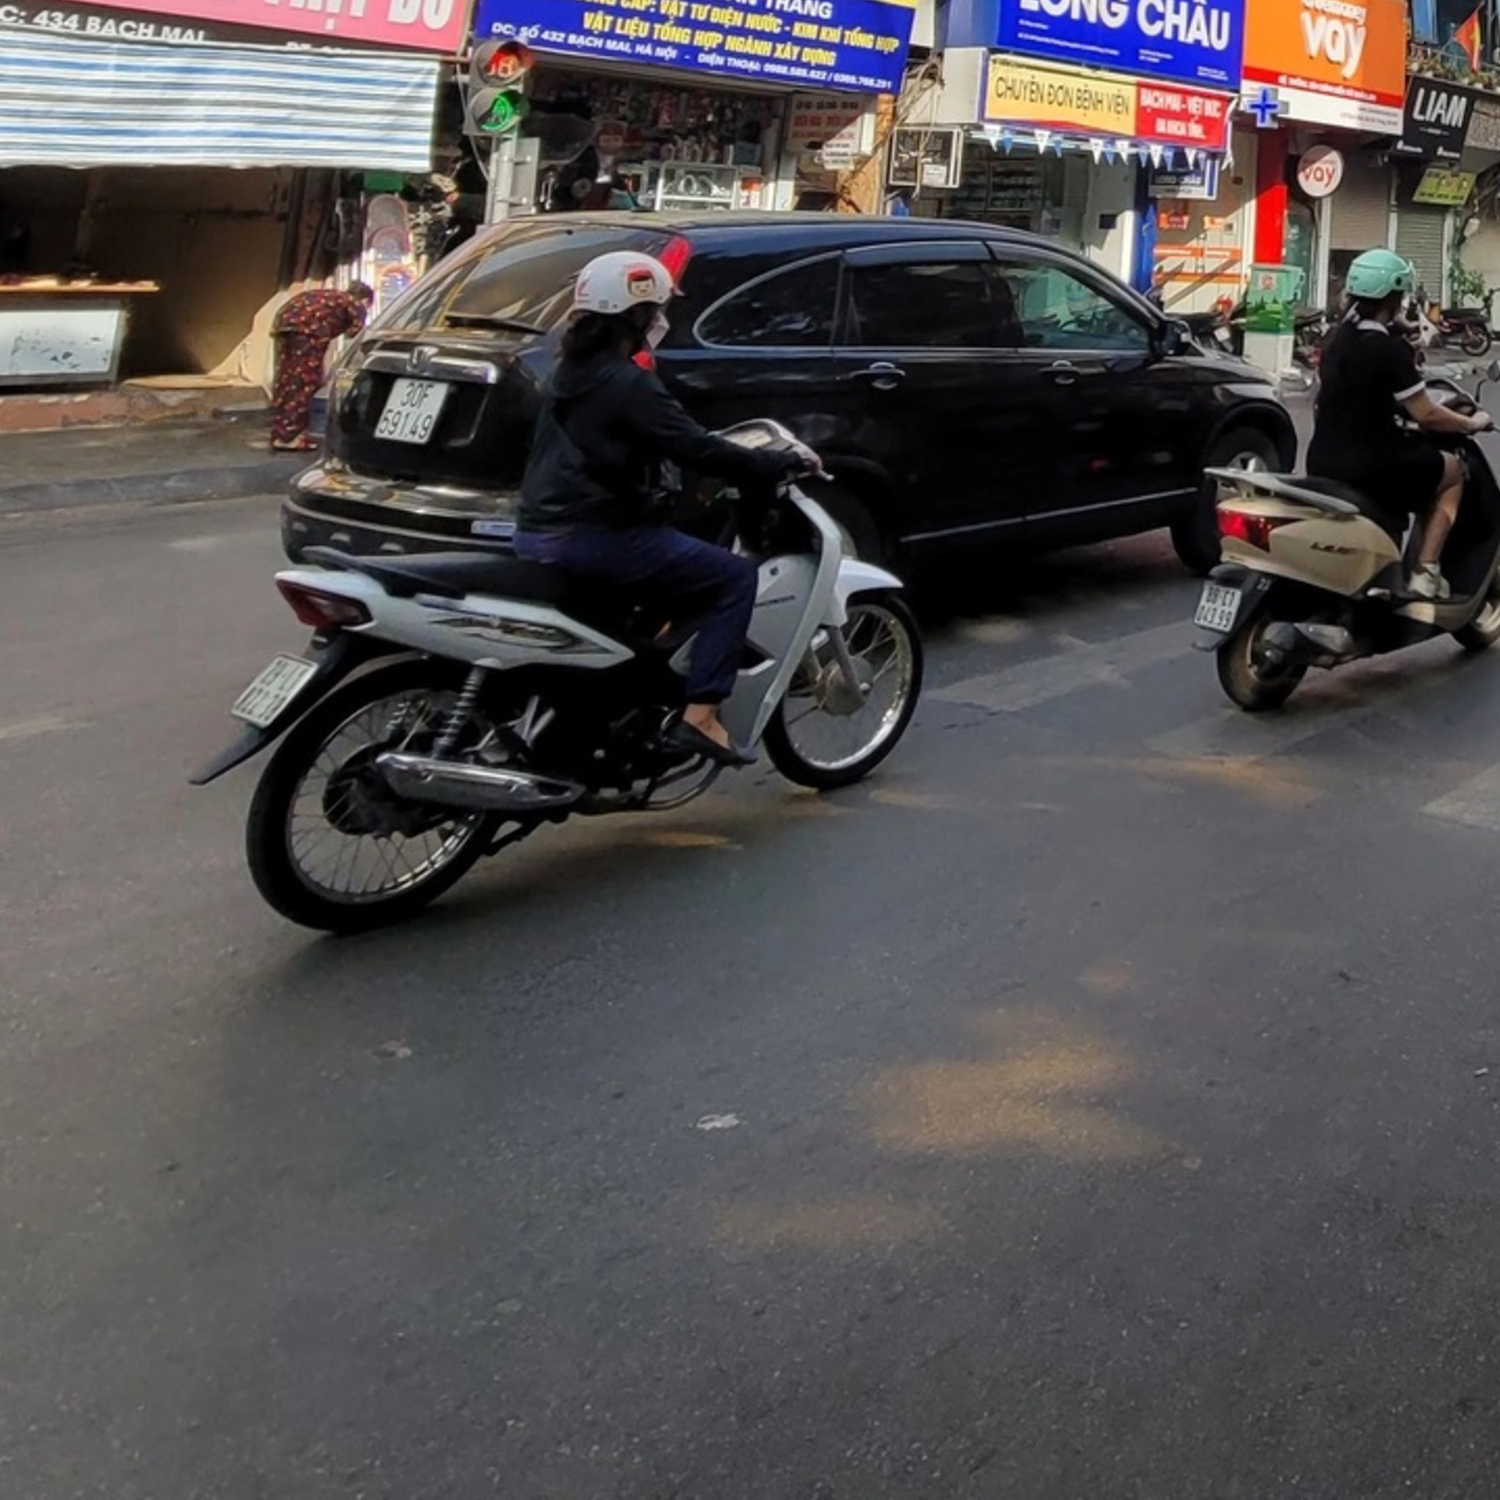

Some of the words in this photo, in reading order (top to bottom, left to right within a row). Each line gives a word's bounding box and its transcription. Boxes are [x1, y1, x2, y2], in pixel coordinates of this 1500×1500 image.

[32, 9, 79, 31] 434
[583, 10, 613, 36] VẬT
[615, 16, 651, 41] LIỆU
[693, 30, 724, 50] HỢP
[724, 34, 772, 58] NGÀNH
[774, 41, 801, 62] XÂY
[690, 3, 709, 21] TƯ
[792, 21, 819, 41] KIM
[541, 29, 566, 43] 432
[566, 33, 604, 50] BẠCH
[1301, 11, 1367, 79] vay
[1046, 85, 1074, 108] ĐƠN
[1075, 84, 1104, 117] BỆNH
[1105, 88, 1131, 121] VIỆN
[1412, 87, 1468, 128] LIAM
[1302, 165, 1336, 188] vay
[401, 381, 435, 408] 30F
